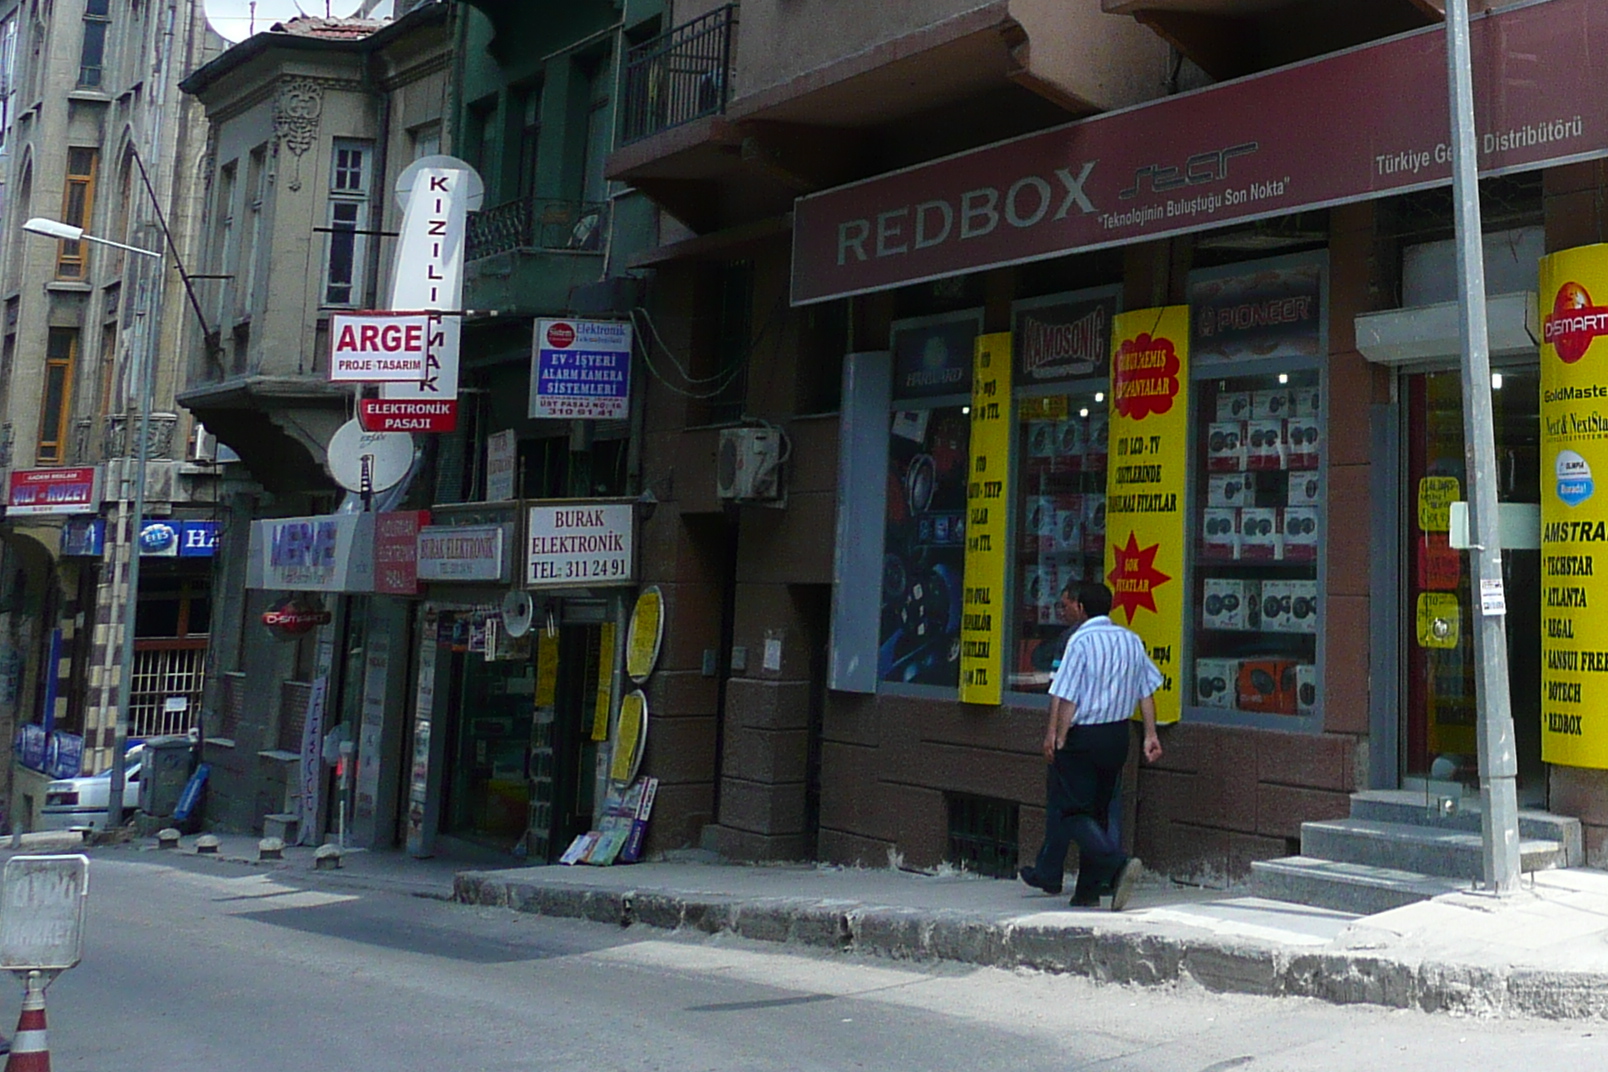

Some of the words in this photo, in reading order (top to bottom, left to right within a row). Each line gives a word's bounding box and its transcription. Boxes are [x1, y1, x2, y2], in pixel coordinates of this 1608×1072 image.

[1376, 149, 1431, 176] Türkiye
[1483, 115, 1583, 155] Distribütörü
[836, 159, 1100, 266] REDBOX
[1166, 192, 1223, 218] Buluştuğu
[1224, 188, 1249, 207] Son
[1217, 295, 1310, 333] PIONEER
[335, 324, 424, 352] ARGE
[338, 359, 372, 372] PROJE
[376, 359, 422, 372] TASARIM
[551, 353, 567, 365] EV
[575, 351, 616, 368] İŞYERİ
[541, 368, 578, 380] ALARM
[580, 369, 623, 382] KAMERA
[547, 380, 617, 395] SİSTEMLERİ
[367, 400, 451, 415] ELEKTRONİK
[384, 417, 432, 430] PASAJI
[1150, 435, 1162, 455] TV
[555, 509, 605, 528] BURAK
[531, 530, 624, 555] ELEKTRONİK
[565, 560, 588, 578] 311
[592, 559, 608, 577] 24
[611, 559, 626, 576] 91
[1547, 555, 1594, 577] TECHSTAR
[1547, 586, 1588, 608] ATLANTA
[1547, 618, 1575, 640] REGAL
[1548, 648, 1579, 672] SANSUI
[1548, 680, 1582, 704] BOTECH
[1548, 711, 1583, 737] REDBOX
